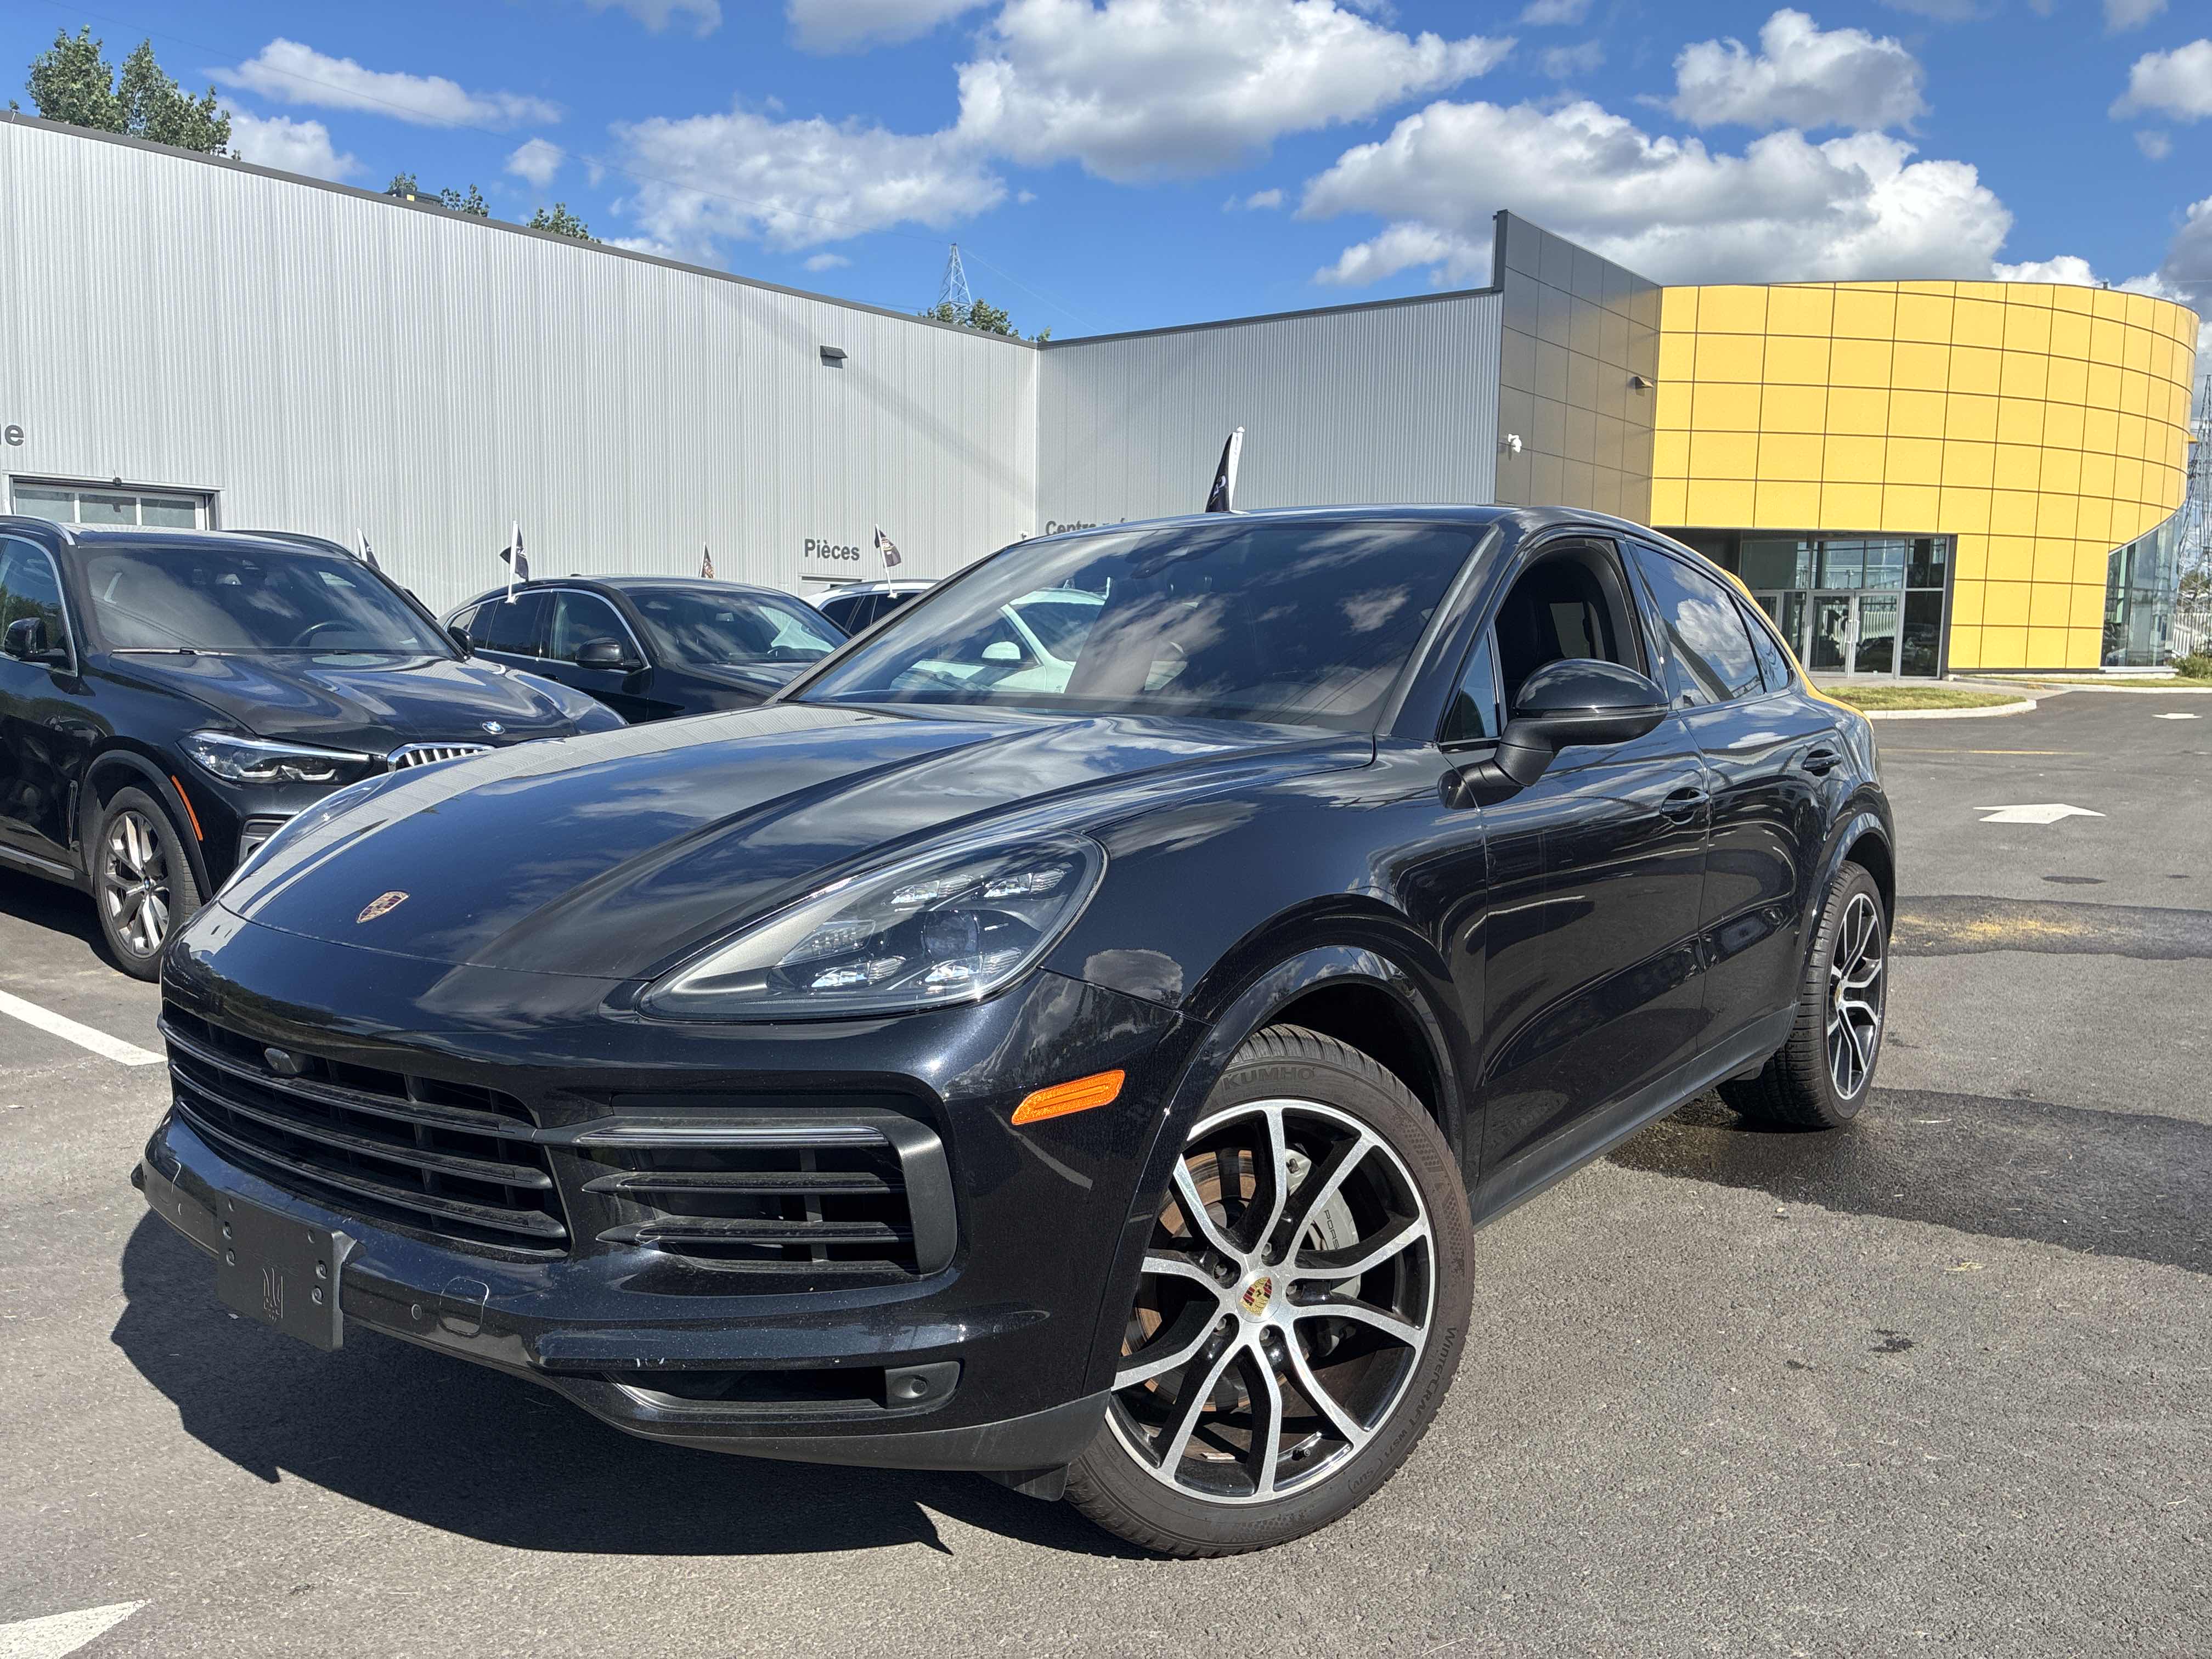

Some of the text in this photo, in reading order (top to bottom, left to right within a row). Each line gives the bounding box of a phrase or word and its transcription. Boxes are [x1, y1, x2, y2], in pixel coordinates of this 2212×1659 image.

[0, 424, 24, 447] e
[804, 538, 860, 561] Pièces
[1223, 1067, 1313, 1090] KUMHO
